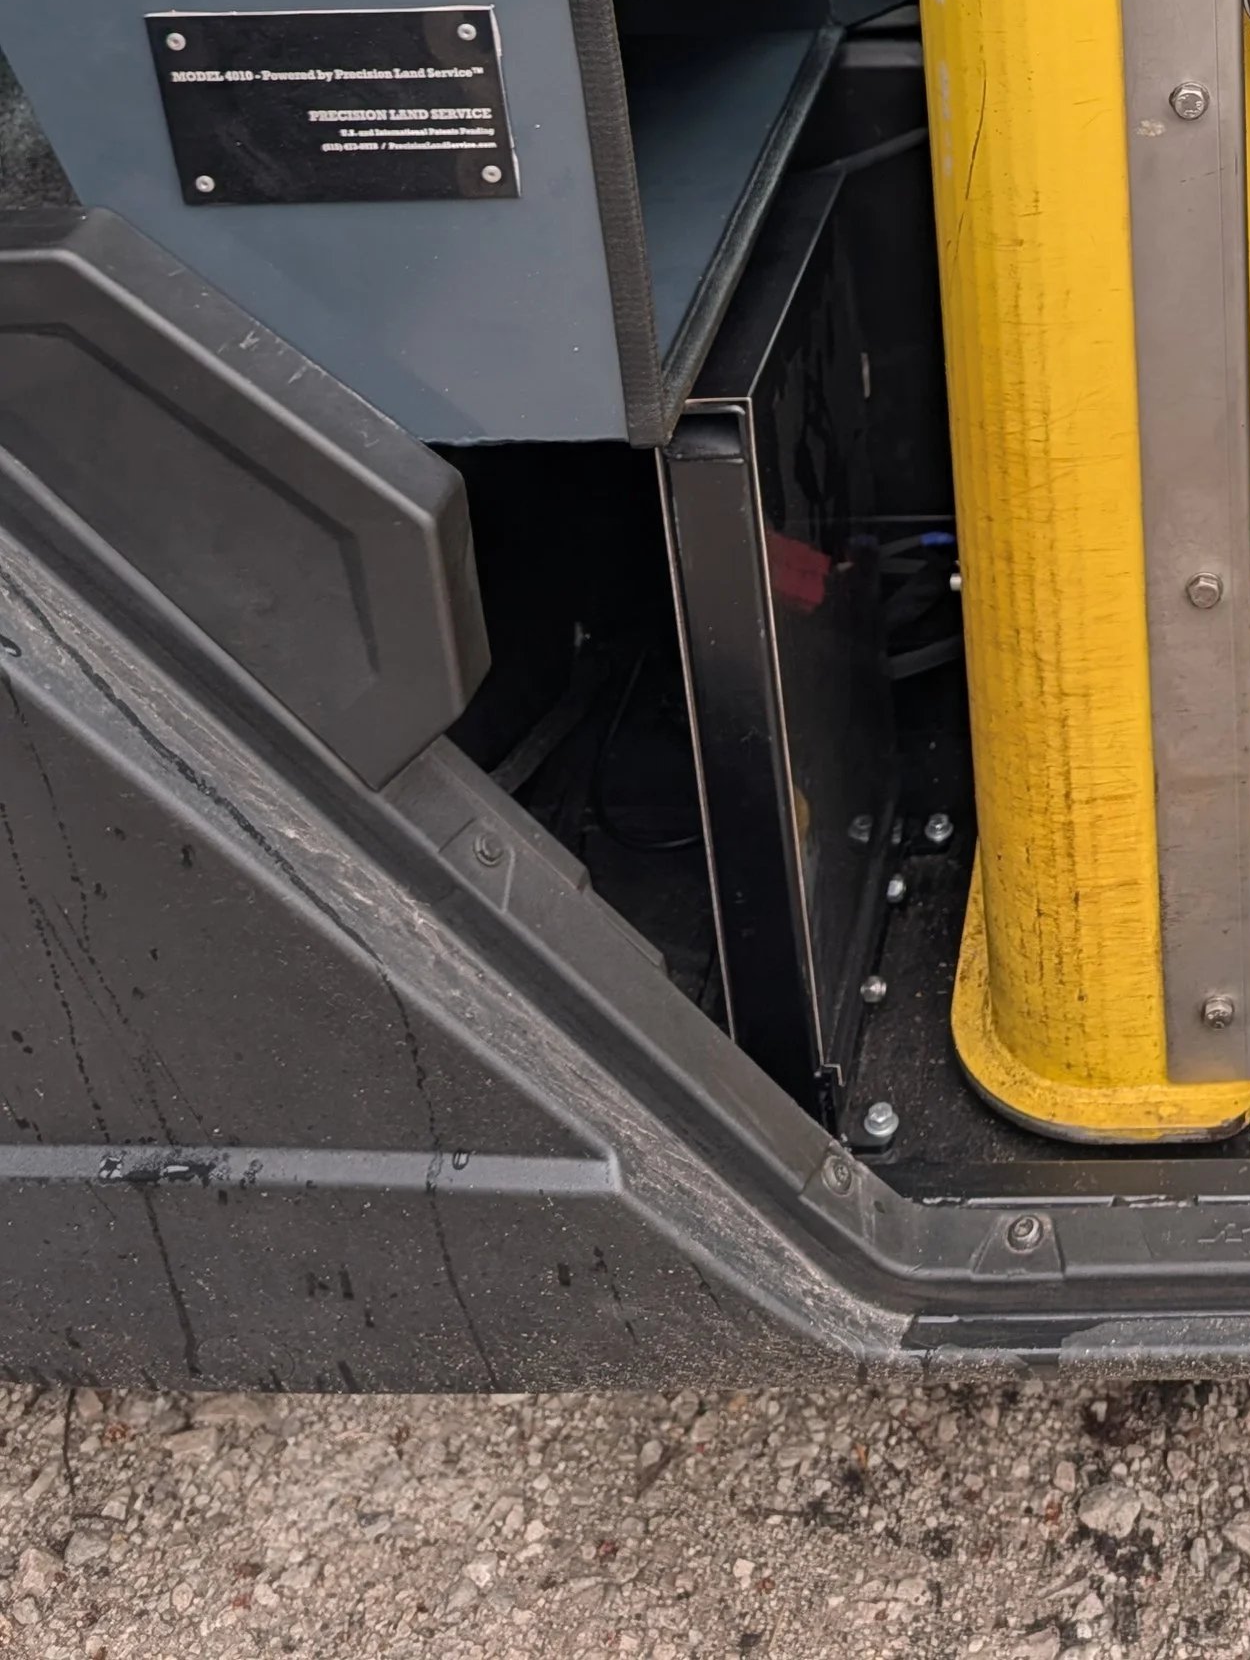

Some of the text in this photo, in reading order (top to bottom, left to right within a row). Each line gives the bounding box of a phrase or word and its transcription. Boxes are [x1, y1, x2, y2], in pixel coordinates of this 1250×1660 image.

[171, 71, 224, 82] MODEL
[225, 70, 254, 81] 4010
[261, 70, 315, 81] Powered
[316, 69, 333, 82] by
[333, 69, 393, 80] Precision
[393, 68, 425, 79] Land
[308, 108, 492, 122] PRECISION LAND SERVICE
[459, 126, 495, 137] Pending
